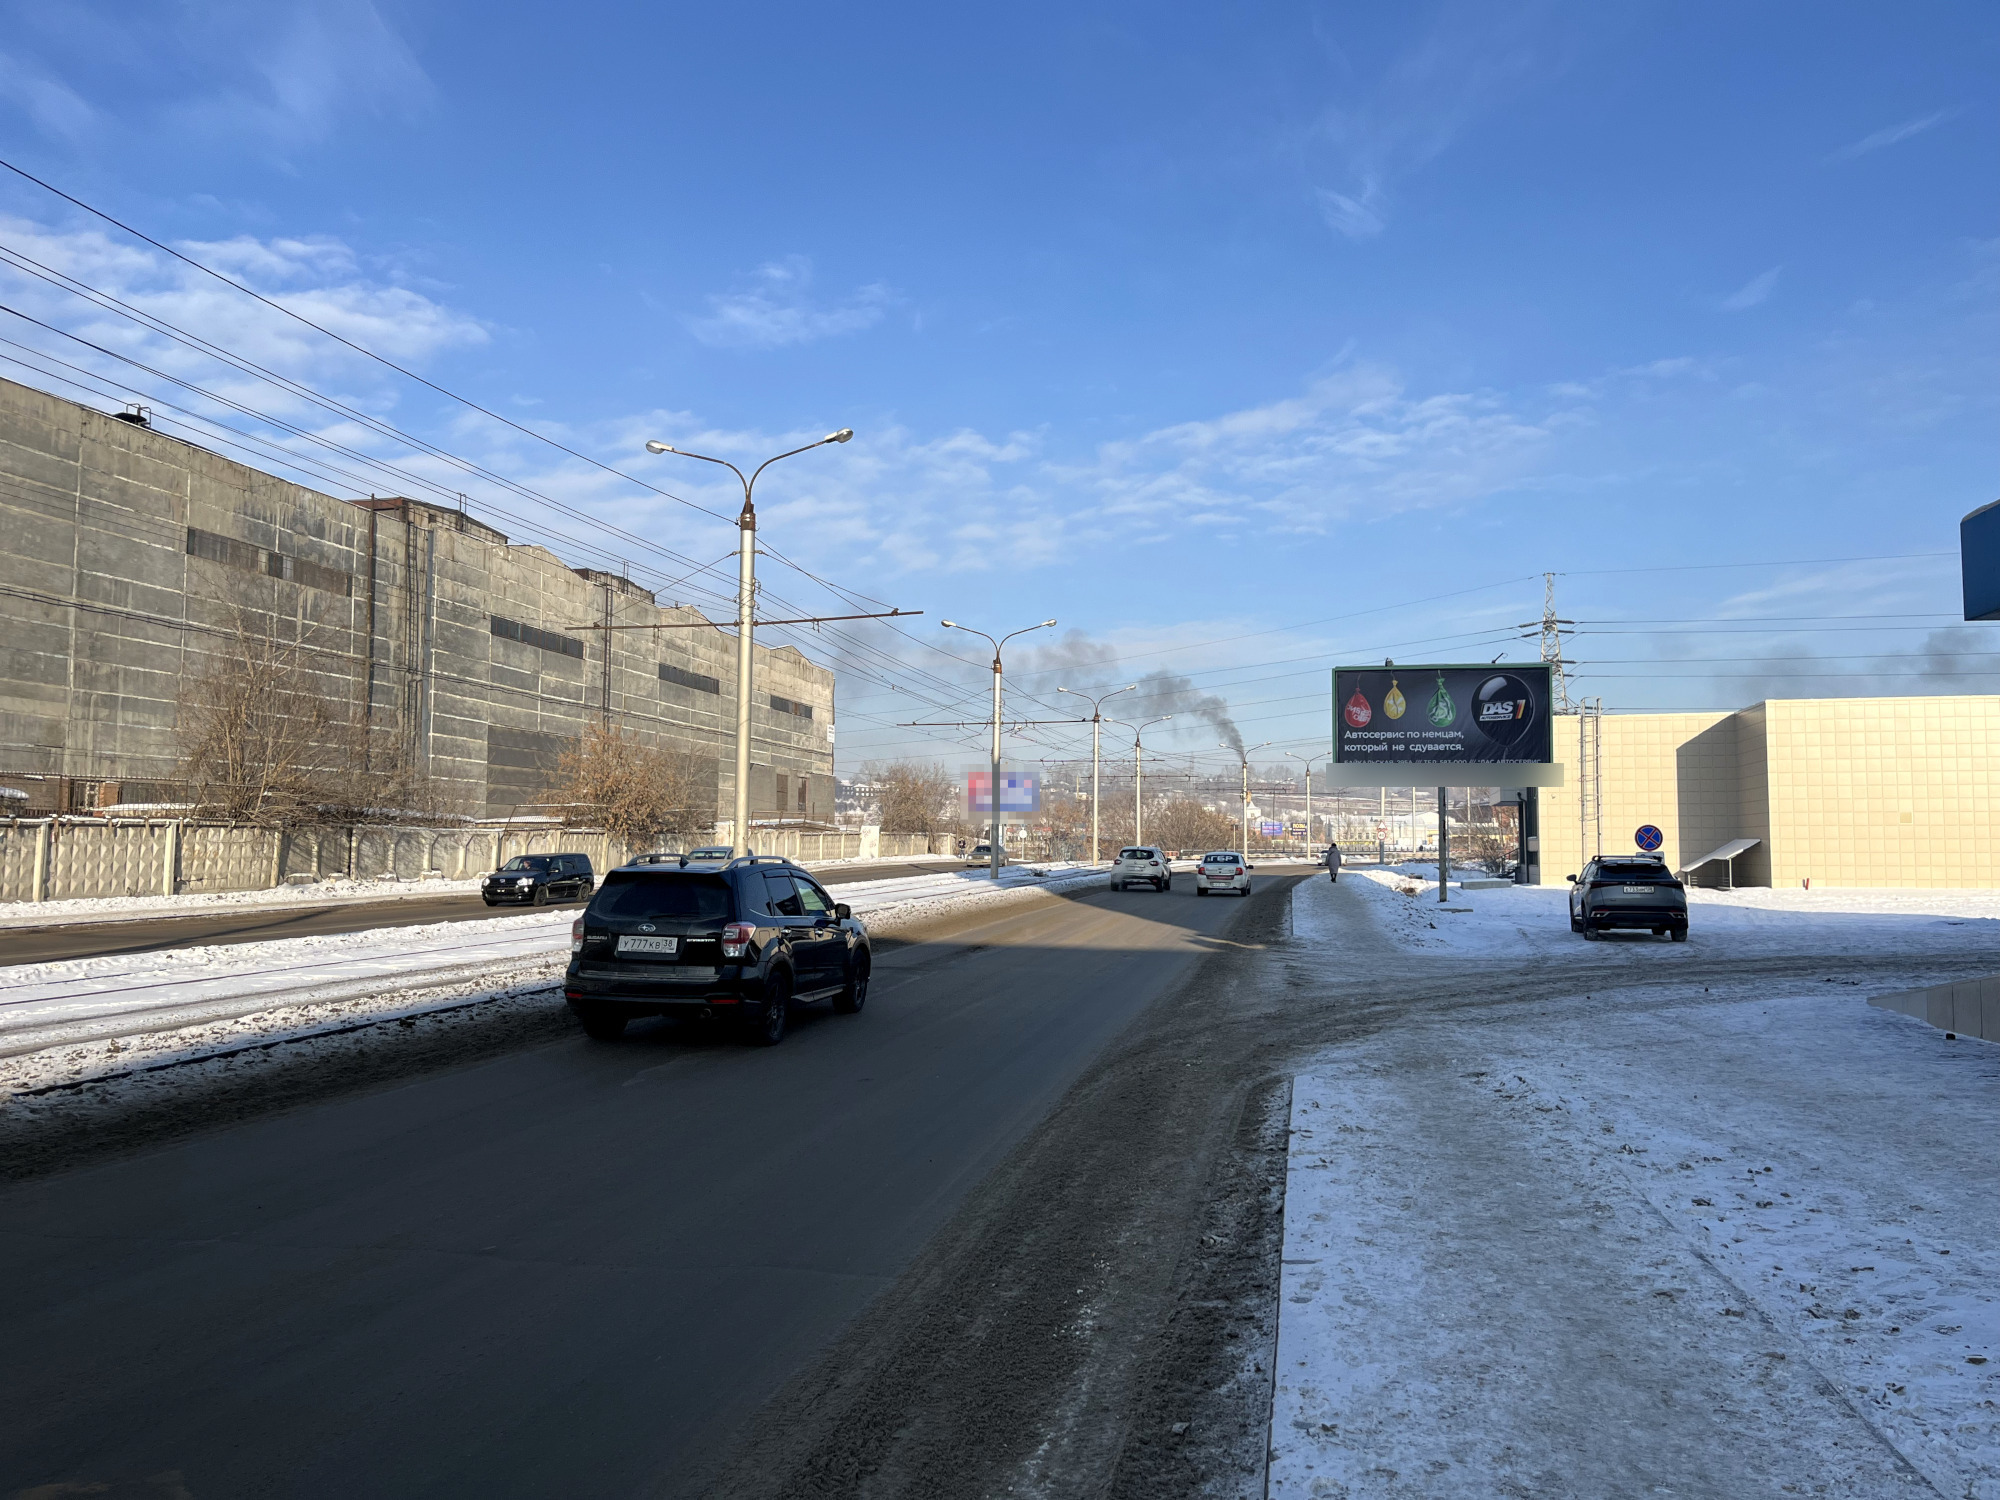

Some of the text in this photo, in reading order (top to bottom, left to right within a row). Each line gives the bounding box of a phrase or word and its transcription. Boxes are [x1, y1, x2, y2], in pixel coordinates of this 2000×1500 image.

[1482, 701, 1514, 714] DAS
[1344, 730, 1464, 740] Автосервис по немцам,
[1344, 742, 1464, 753] который не сдувается.
[663, 939, 673, 947] 38
